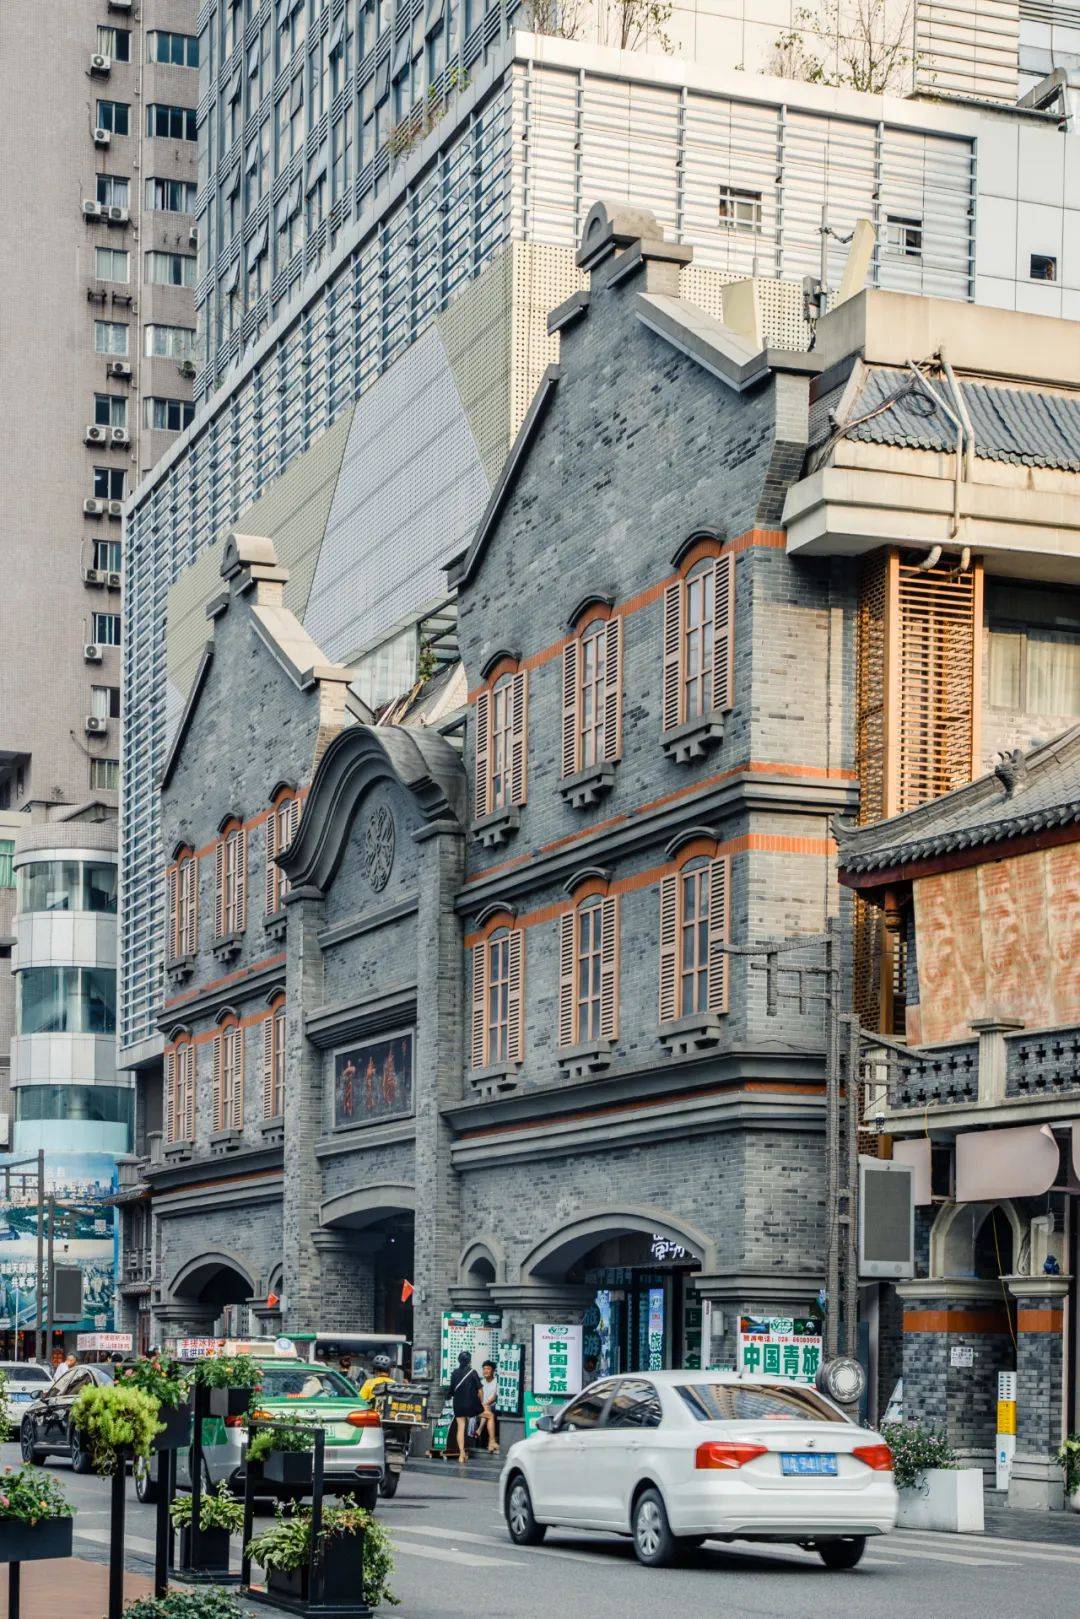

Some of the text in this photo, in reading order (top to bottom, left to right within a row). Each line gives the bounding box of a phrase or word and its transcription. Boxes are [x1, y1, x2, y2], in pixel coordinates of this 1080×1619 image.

[549, 1341, 567, 1392] 中国青旅
[743, 1342, 819, 1375] 中国青旅
